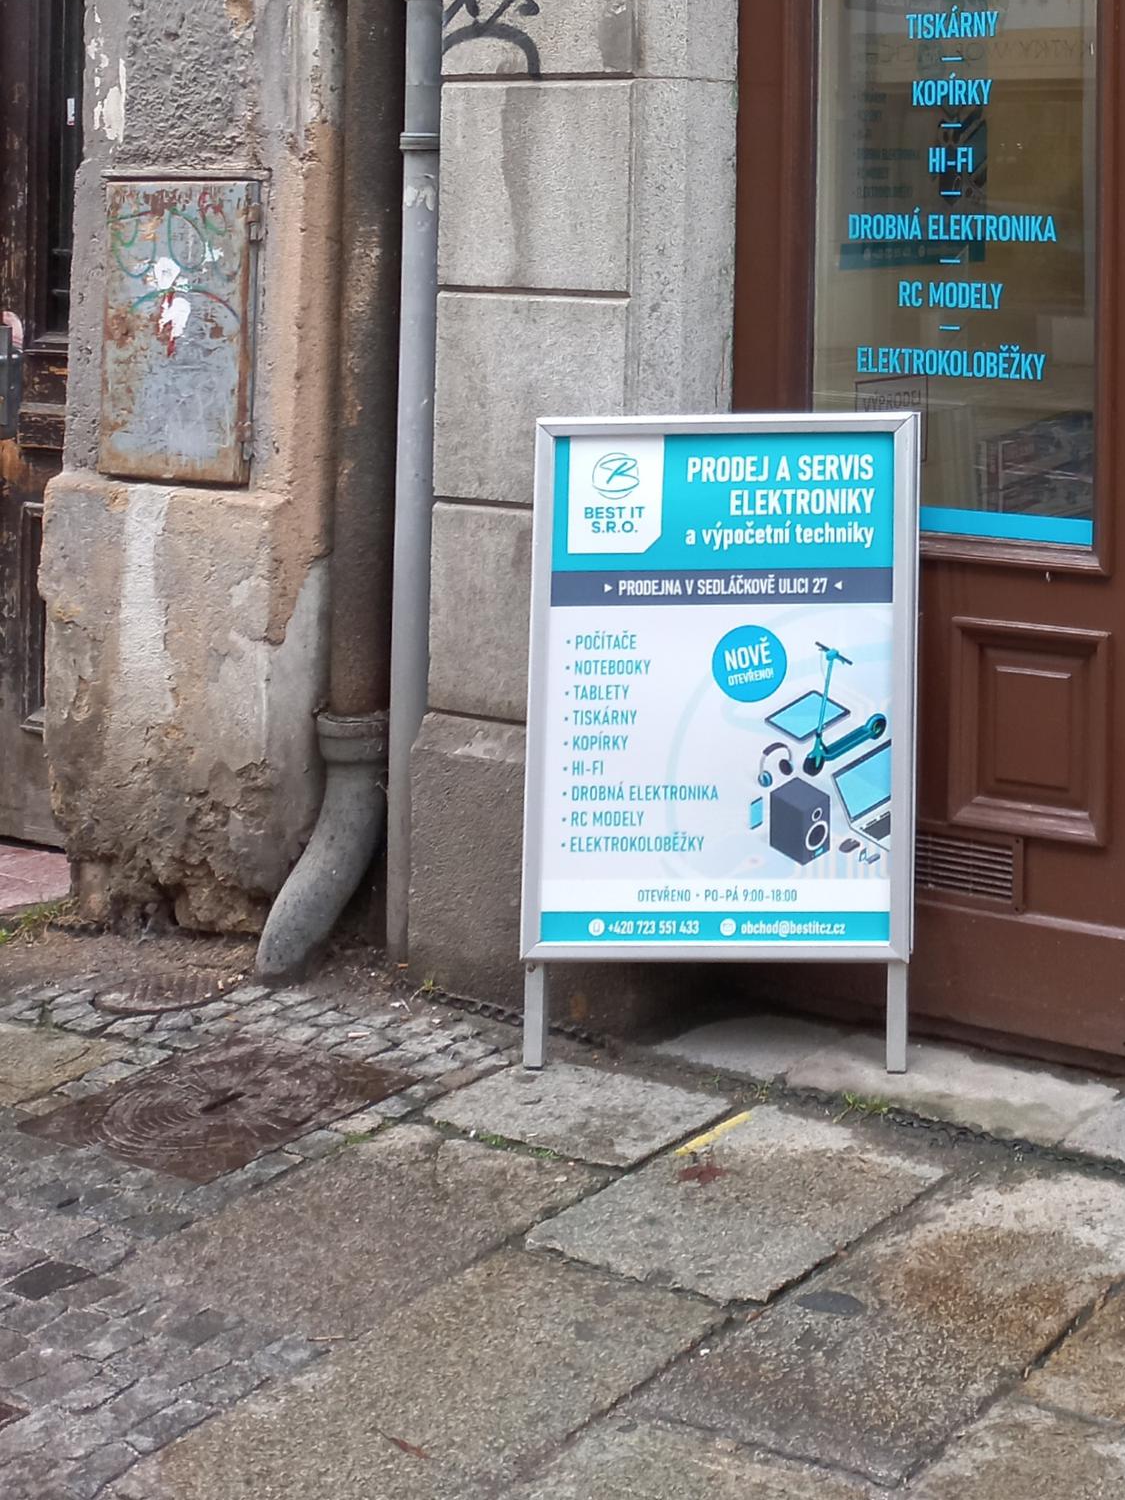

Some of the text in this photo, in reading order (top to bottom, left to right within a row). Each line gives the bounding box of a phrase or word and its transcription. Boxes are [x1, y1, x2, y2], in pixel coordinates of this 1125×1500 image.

[906, 5, 998, 39] TISKÁRNY
[912, 73, 992, 106] KOPÍRKY
[928, 147, 973, 173] HI-FI
[848, 206, 1057, 242] DROBNÁ ELEKTRONIKA
[898, 281, 1003, 309] RC MODELY
[856, 344, 1045, 381] ELEKTROKOLOBĚŽKY
[687, 453, 874, 483] PRODEJ A SERVIS
[584, 506, 645, 519] BEST IT
[729, 488, 875, 517] ELEKTRONIKY
[591, 521, 637, 533] S.R.O.
[685, 521, 874, 551] a výpočetní techniky
[618, 574, 828, 596] PRODEJNA V SEDLÁČKOVĚ ULICI 27
[575, 631, 637, 650] POČÍTAČE
[724, 638, 772, 671] NOVĚ
[574, 659, 651, 675] NOTEBOOKY
[728, 666, 774, 686] OTEVŘENO!
[573, 685, 629, 701] TABLETY
[572, 706, 637, 725] TISKÁRNY
[572, 731, 628, 750] KOPÍRKY
[572, 761, 604, 776] HI-FI
[571, 782, 719, 801] DROBNÁ ELEKTRONIKA
[571, 811, 644, 827] RC MODELY
[570, 831, 704, 853] ELEKTROKOLOBĚŽKY
[637, 886, 691, 902] OTEVŘENO
[704, 885, 738, 901] PO-PÁ
[608, 920, 699, 935] +420 723 551 433
